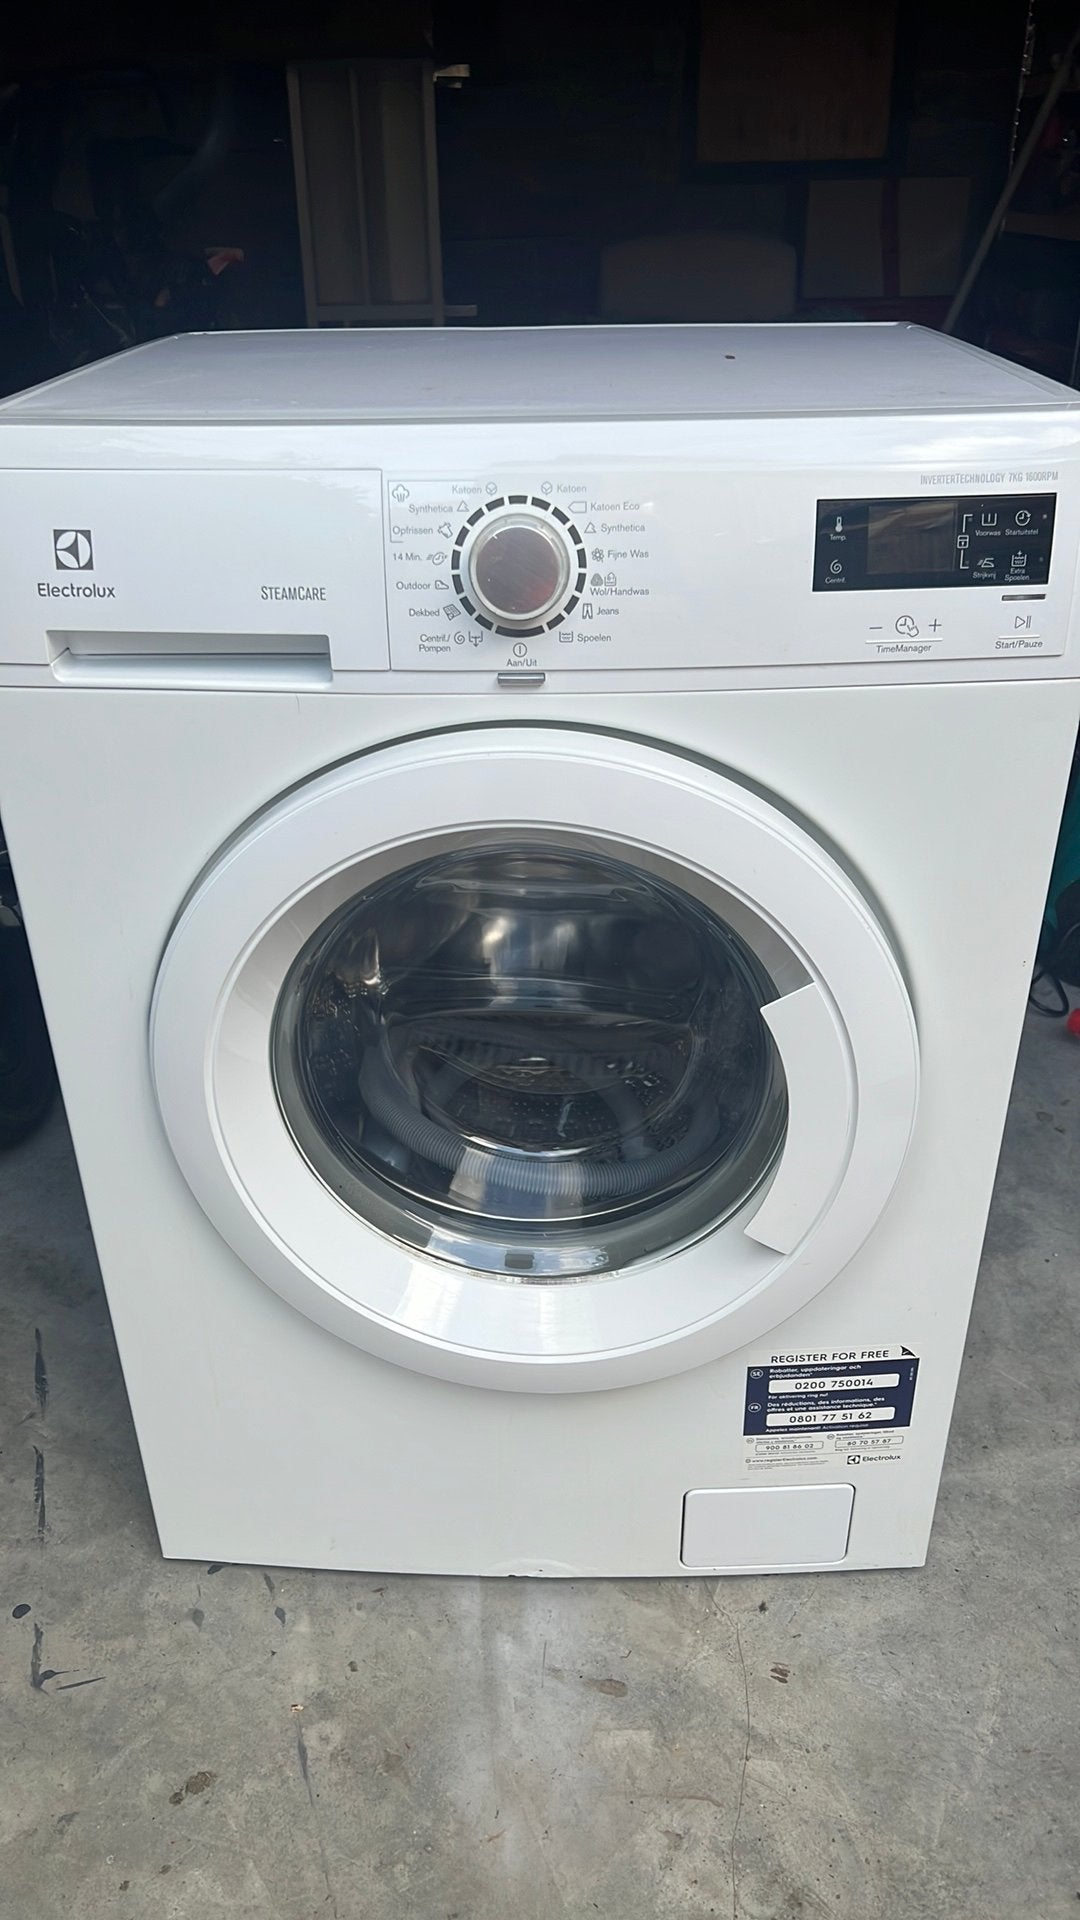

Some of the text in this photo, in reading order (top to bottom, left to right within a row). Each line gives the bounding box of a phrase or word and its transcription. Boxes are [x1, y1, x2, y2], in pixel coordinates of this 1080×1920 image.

[1009, 472, 1022, 482] 7KG
[1026, 472, 1058, 481] 1600RPM
[452, 485, 482, 494] Katoen
[409, 505, 453, 515] Synthetica
[591, 503, 620, 511] Katoen
[392, 526, 433, 535] Opfrissen
[601, 524, 645, 534] Synthetica
[608, 550, 648, 559] Fijne Was
[37, 583, 115, 598] Electrolux
[396, 582, 431, 590] Outdoor
[261, 586, 326, 601] STEAMCARE
[590, 587, 649, 596] Wol/Handwas
[420, 634, 450, 643] Centrif./
[577, 634, 611, 643] Spoelen
[419, 645, 450, 653] Pompen
[876, 644, 931, 653] TimeManager
[995, 640, 1043, 650] Start/Pauze
[771, 1350, 889, 1364] REGISTER FOR FREE
[795, 1379, 873, 1390] 0200 750014
